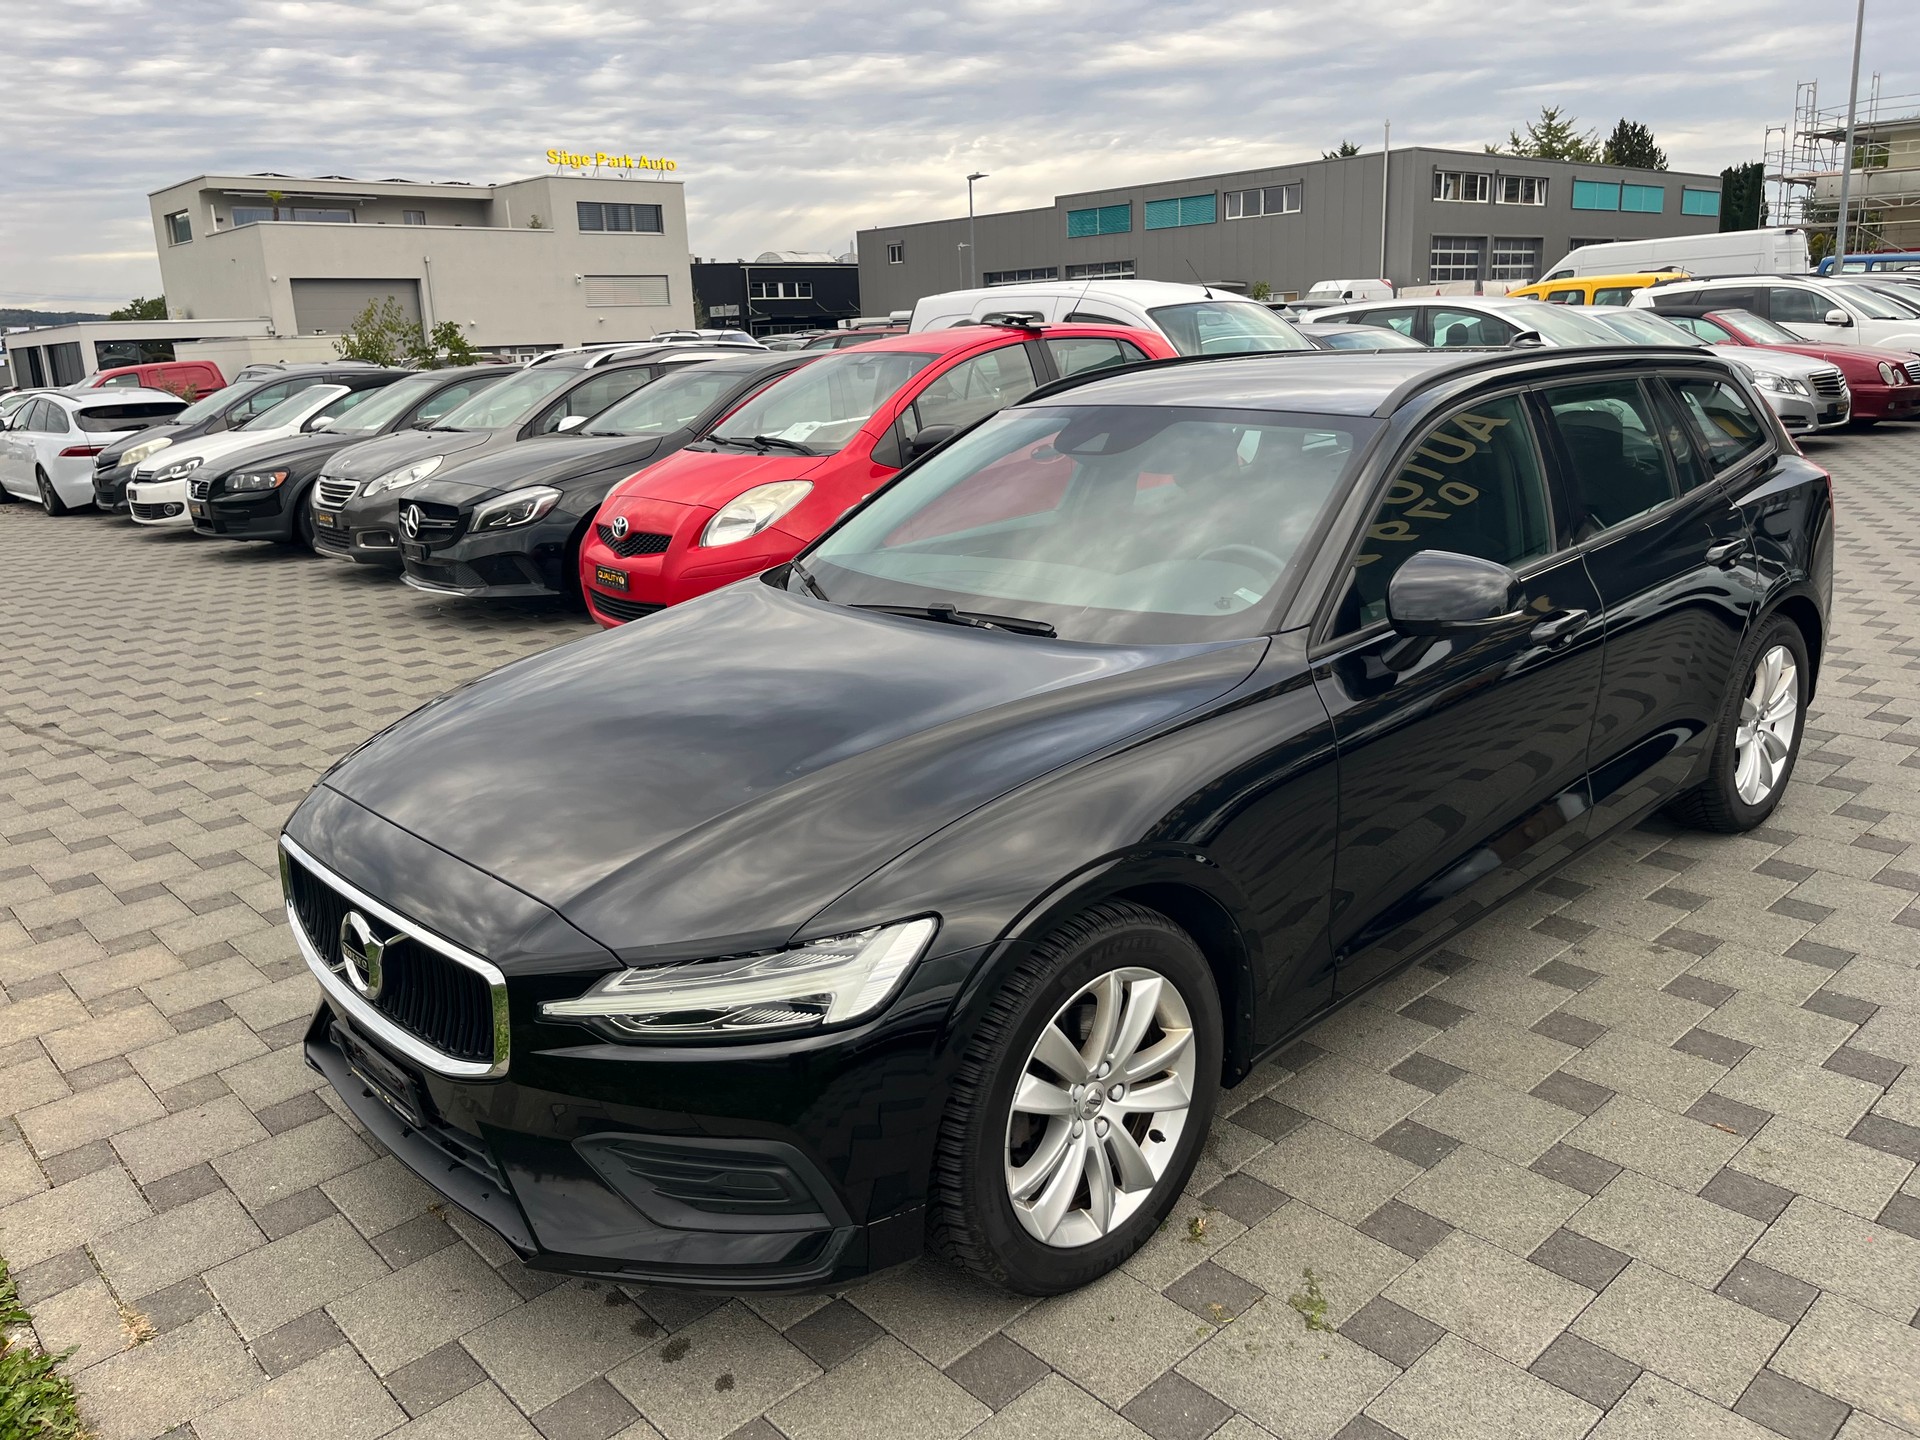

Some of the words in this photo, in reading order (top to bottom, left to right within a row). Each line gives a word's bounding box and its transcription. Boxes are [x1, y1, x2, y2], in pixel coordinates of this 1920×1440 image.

[546, 148, 591, 169] Säge
[595, 152, 634, 168] Park
[638, 155, 677, 171] Auto
[342, 944, 368, 969] VOLVO
